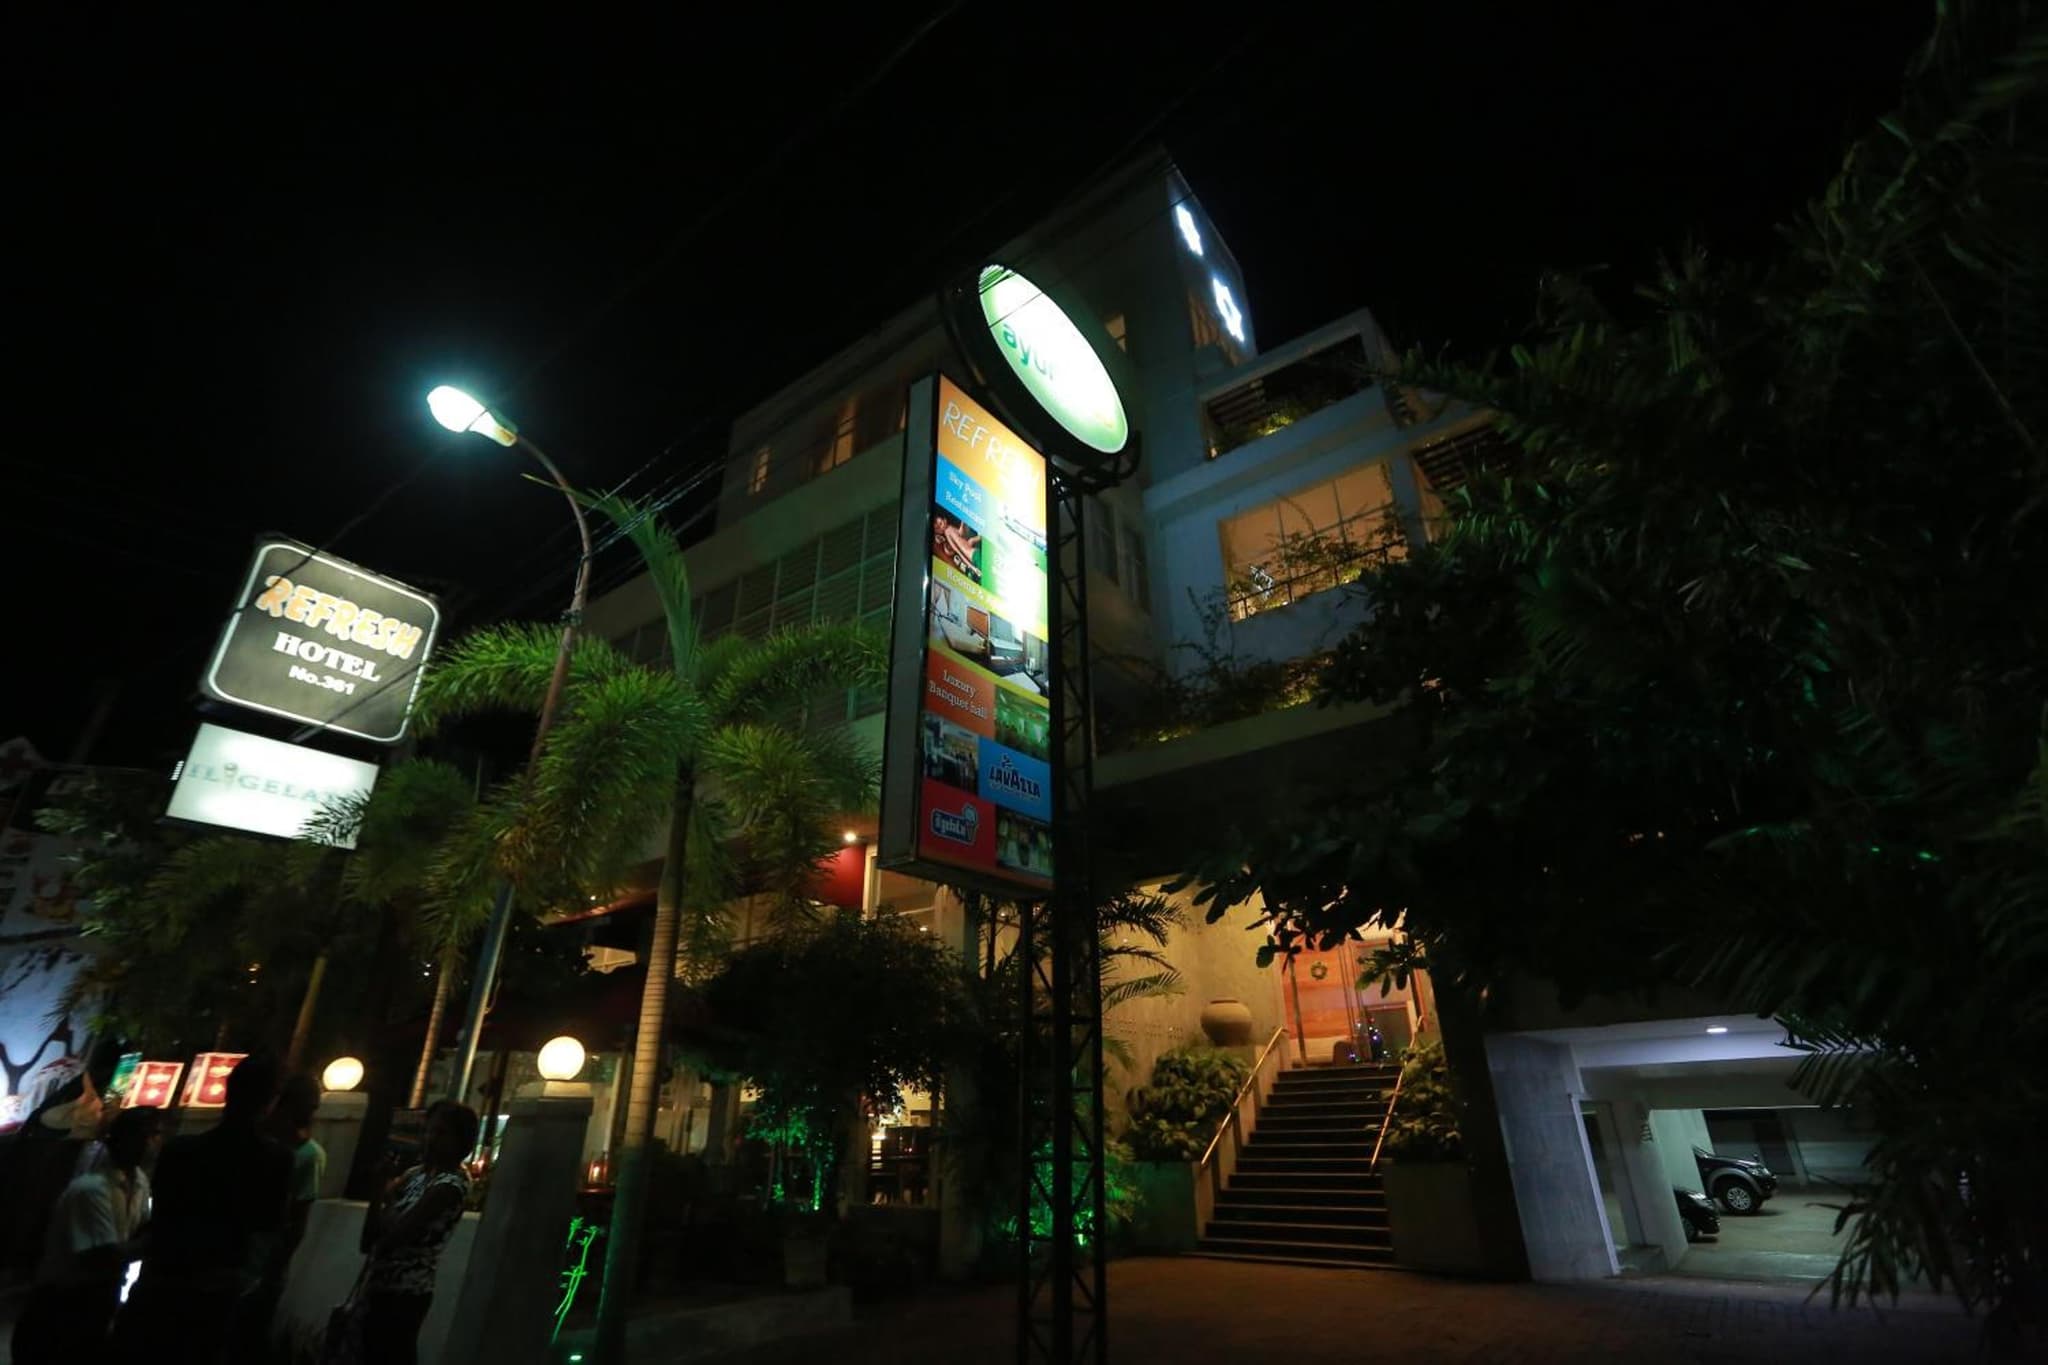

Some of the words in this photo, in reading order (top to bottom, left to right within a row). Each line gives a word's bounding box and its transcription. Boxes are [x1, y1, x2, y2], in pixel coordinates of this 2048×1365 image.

[256, 575, 422, 660] REFRESH
[273, 632, 381, 682] HOTEL
[928, 680, 969, 711] Banquet
[943, 669, 976, 698] Luxury
[989, 765, 1041, 798] LAVAZZA
